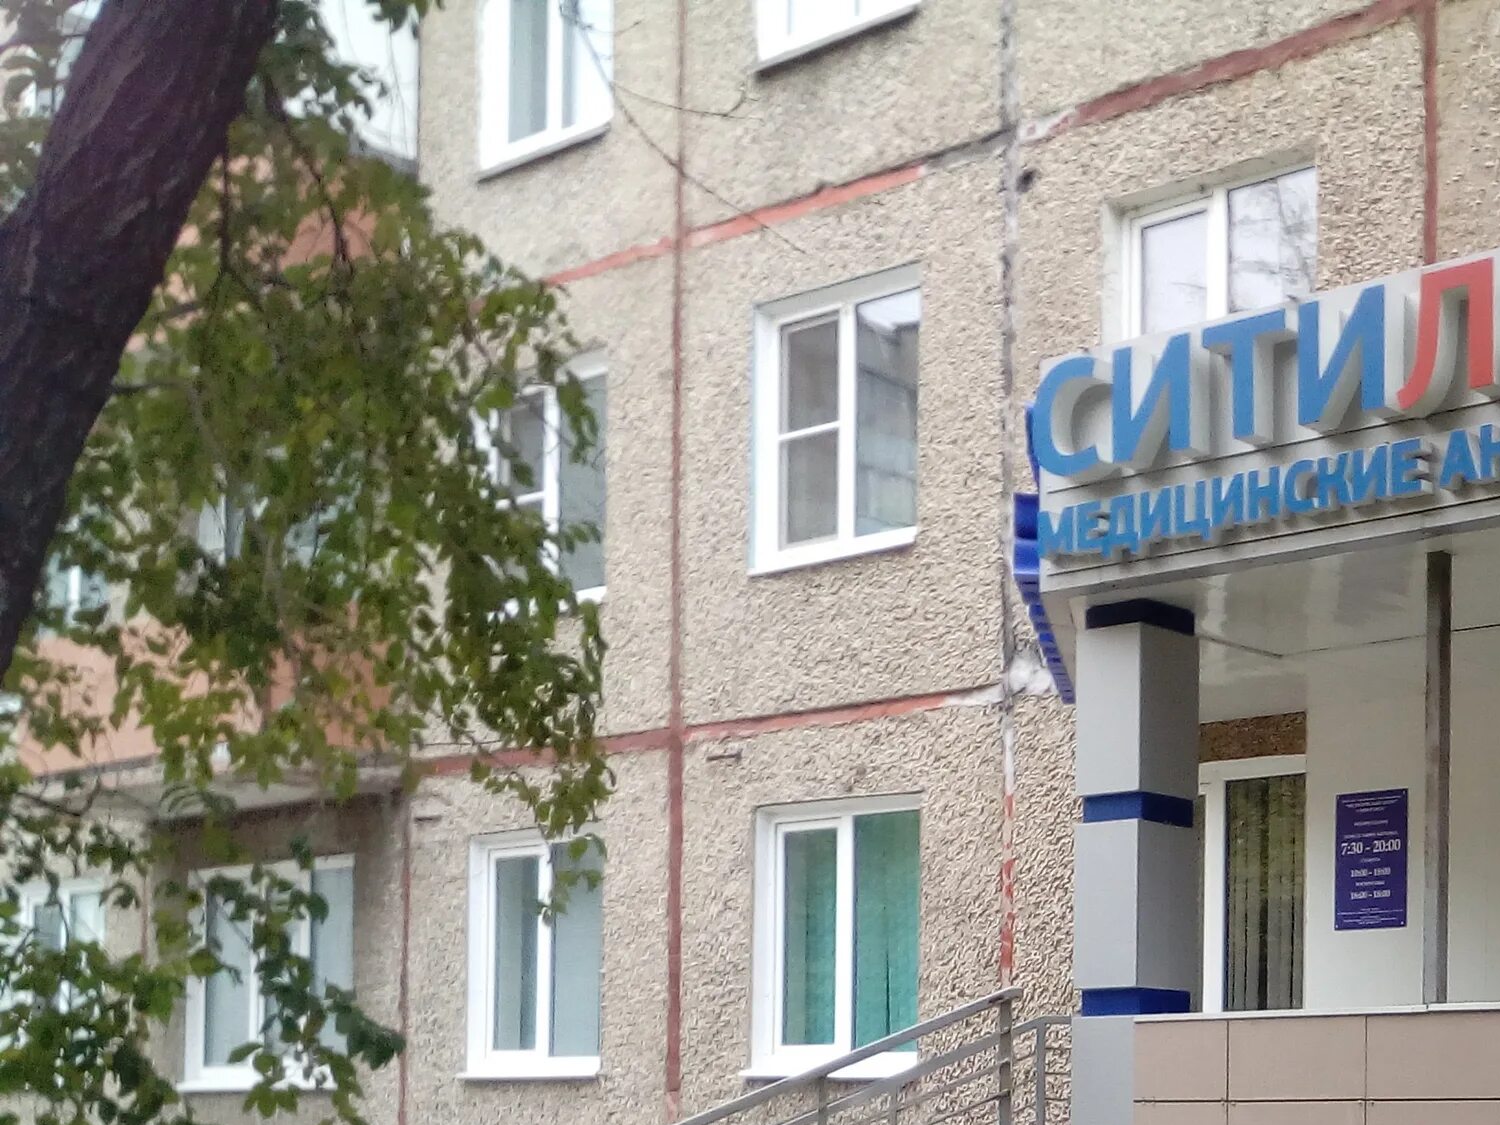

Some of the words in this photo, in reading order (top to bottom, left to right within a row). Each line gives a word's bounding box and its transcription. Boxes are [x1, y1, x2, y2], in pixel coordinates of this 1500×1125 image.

[1039, 438, 1425, 561] МЕДИЦИНСКИЕ
[1341, 841, 1363, 856] 7:30
[1373, 838, 1401, 854] 20:00
